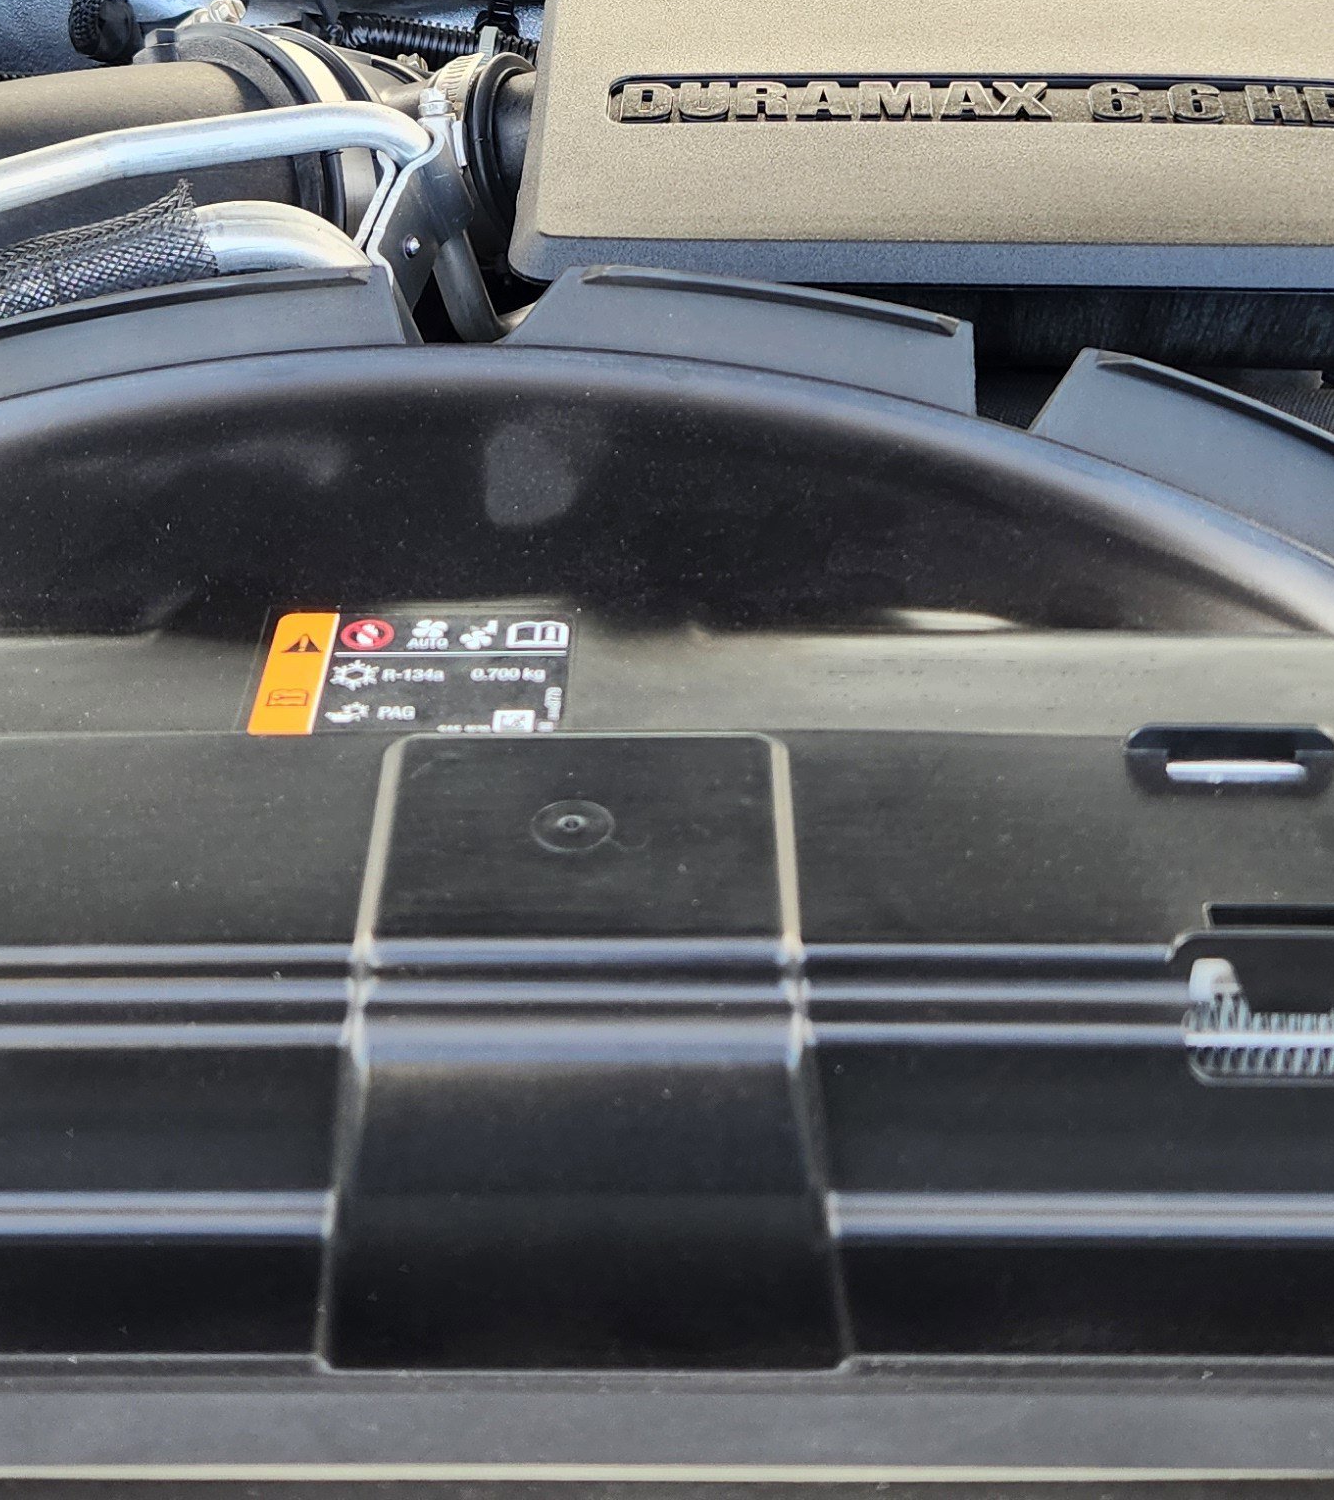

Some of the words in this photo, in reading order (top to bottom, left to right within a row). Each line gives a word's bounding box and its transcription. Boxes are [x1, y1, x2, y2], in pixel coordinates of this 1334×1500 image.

[619, 80, 1054, 122] DURAMAX
[1088, 81, 1225, 123] 6.6
[406, 637, 449, 650] AUTO
[381, 667, 445, 682] R-134a
[470, 667, 521, 682] 0.700
[521, 667, 546, 683] kg
[376, 705, 416, 720] PAG
